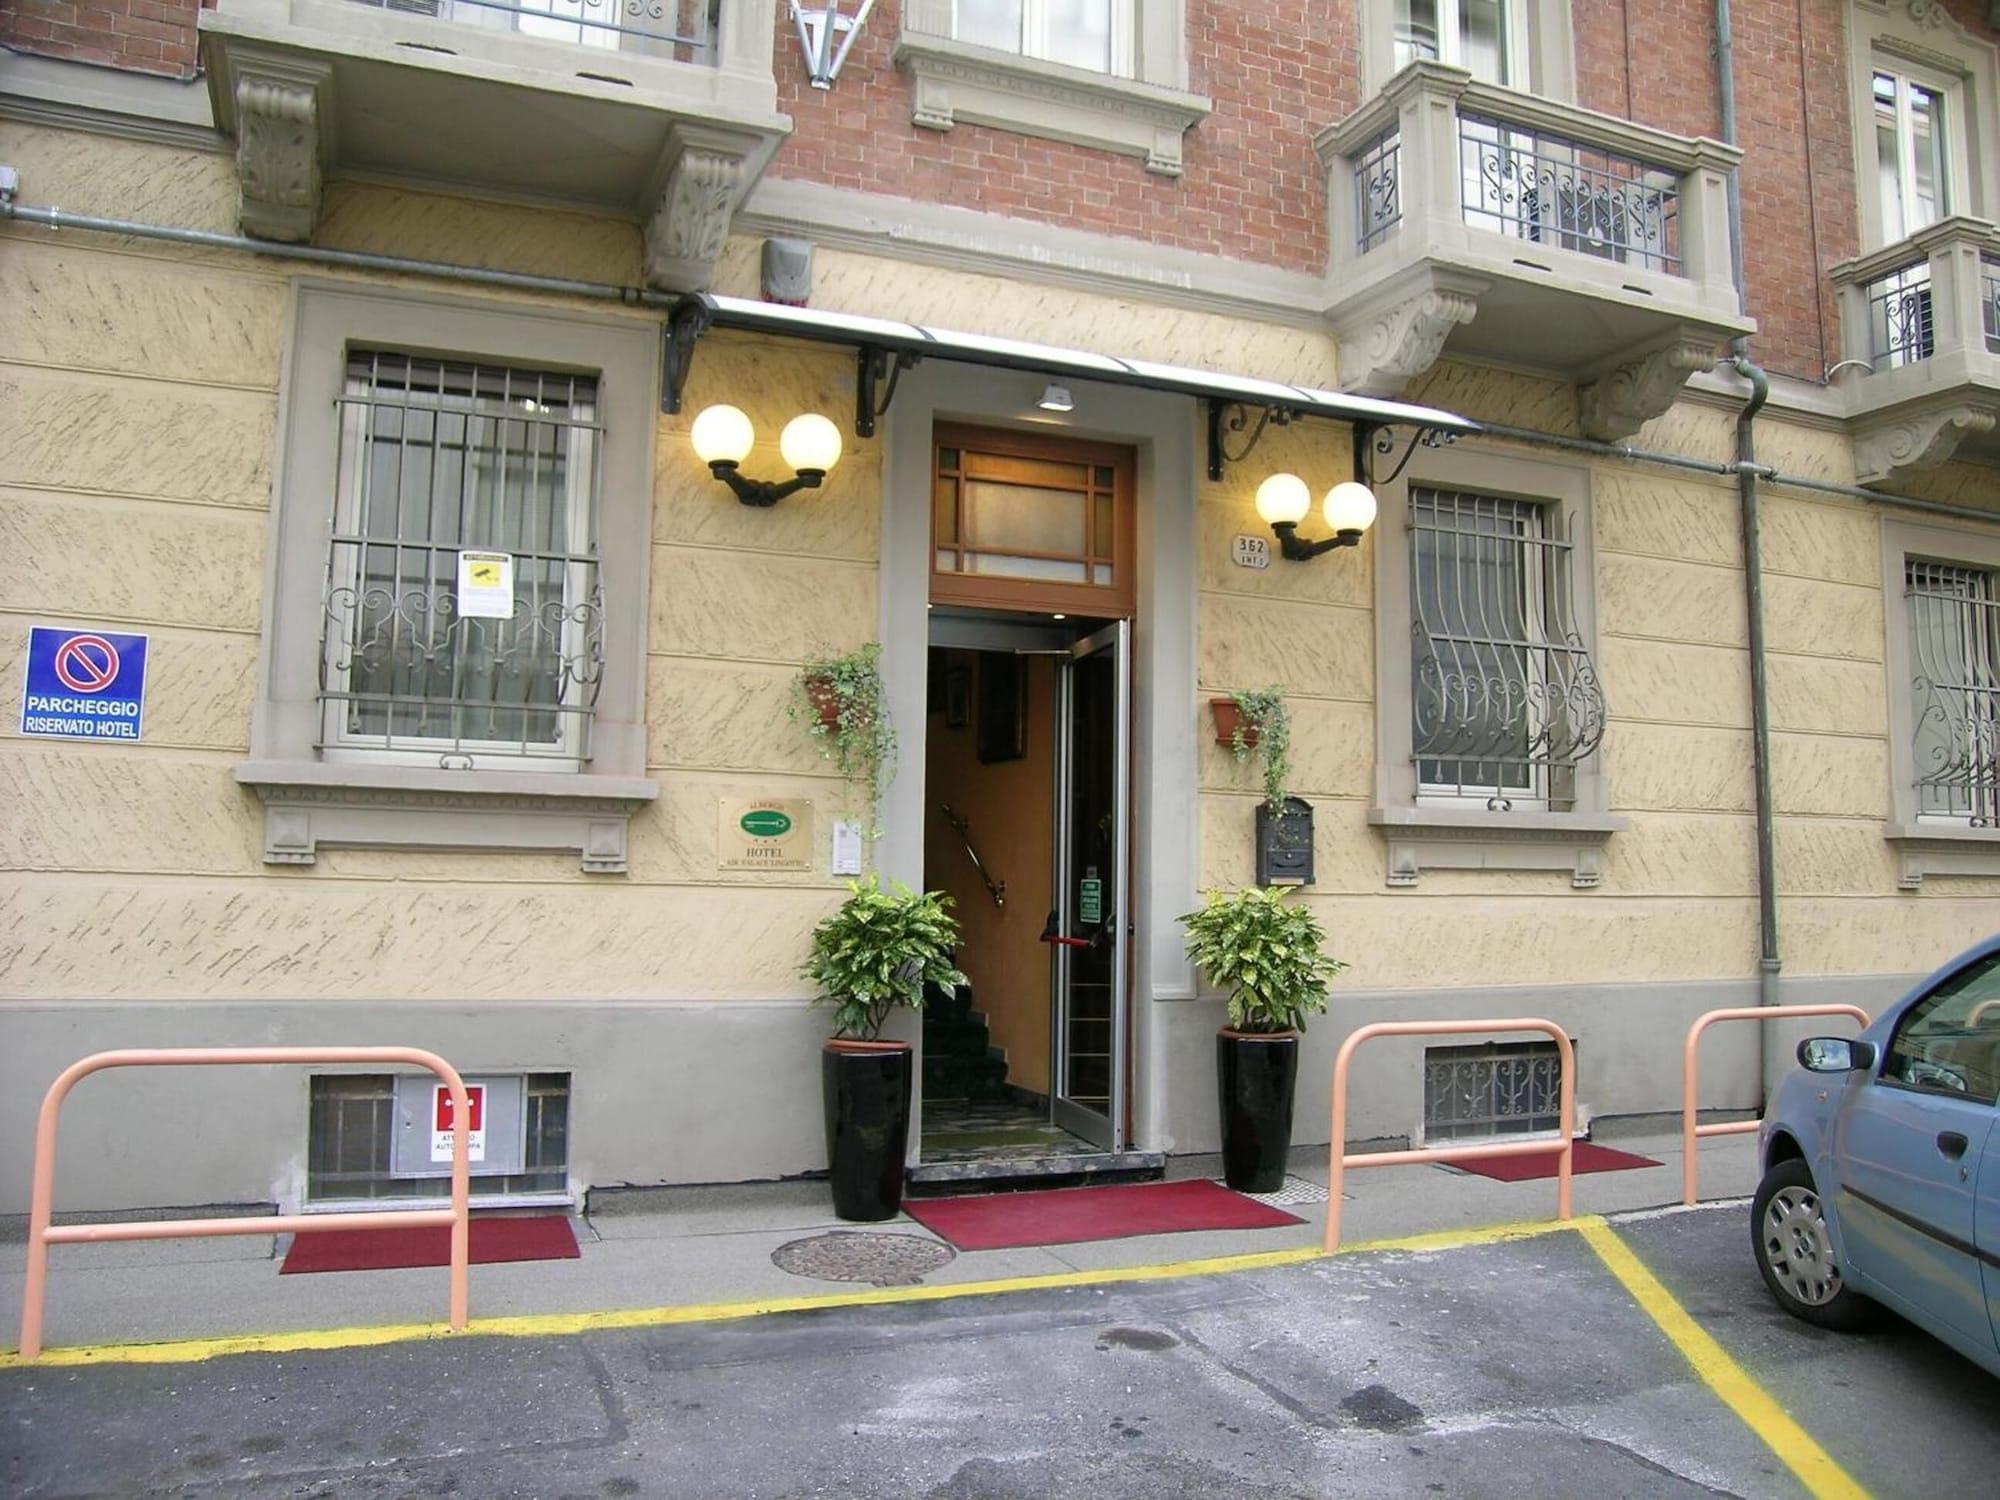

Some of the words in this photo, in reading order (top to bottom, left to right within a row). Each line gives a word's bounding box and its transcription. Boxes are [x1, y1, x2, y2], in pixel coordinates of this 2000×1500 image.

[1240, 538, 1264, 552] 362
[27, 696, 138, 717] PARCHEGGIO
[25, 717, 94, 735] RISERVATO
[96, 721, 137, 737] HOTEL
[746, 847, 785, 858] HOTEL
